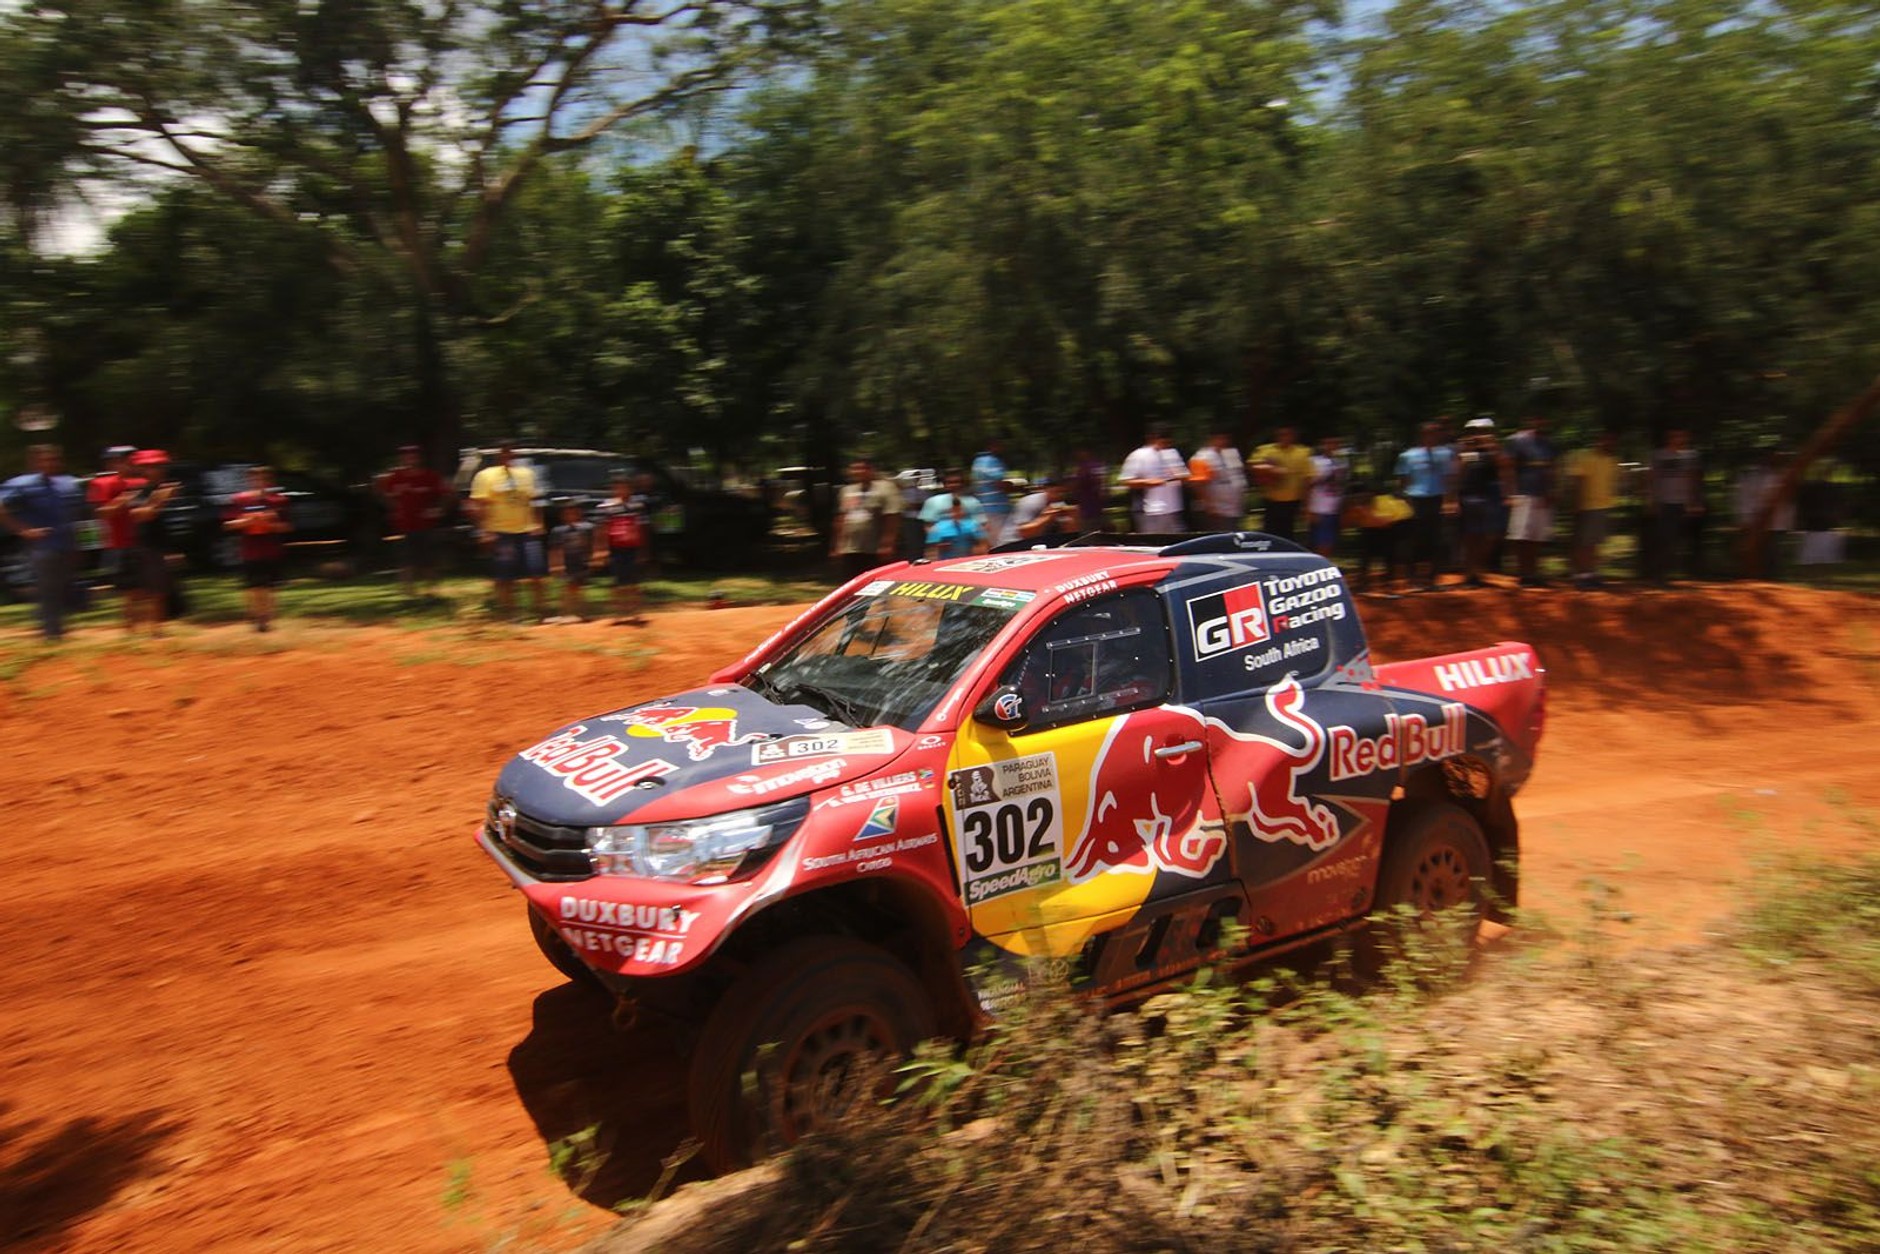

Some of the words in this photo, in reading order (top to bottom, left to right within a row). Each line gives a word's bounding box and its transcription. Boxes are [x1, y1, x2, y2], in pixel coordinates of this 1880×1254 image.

[889, 583, 975, 601] HILUX
[1054, 570, 1110, 593] DUXBURY
[1063, 580, 1118, 604] NETGEAR
[1263, 566, 1343, 596] TOYOTA
[1268, 584, 1342, 615] GAZOO
[1197, 607, 1267, 654] GR
[1273, 602, 1347, 634] Racing
[1244, 647, 1283, 671] South
[1283, 637, 1320, 659] Africa
[1434, 652, 1533, 691] HILUX
[797, 739, 839, 754] 302
[1002, 757, 1051, 774] PARAGUAY
[1018, 770, 1052, 783] BOLIVIA
[1002, 779, 1053, 797] ARGENTINA
[964, 797, 1055, 872] 302
[969, 863, 1056, 899] SpeedAgro
[560, 896, 702, 934] DUXBURY
[562, 927, 685, 964] NETGEAR
